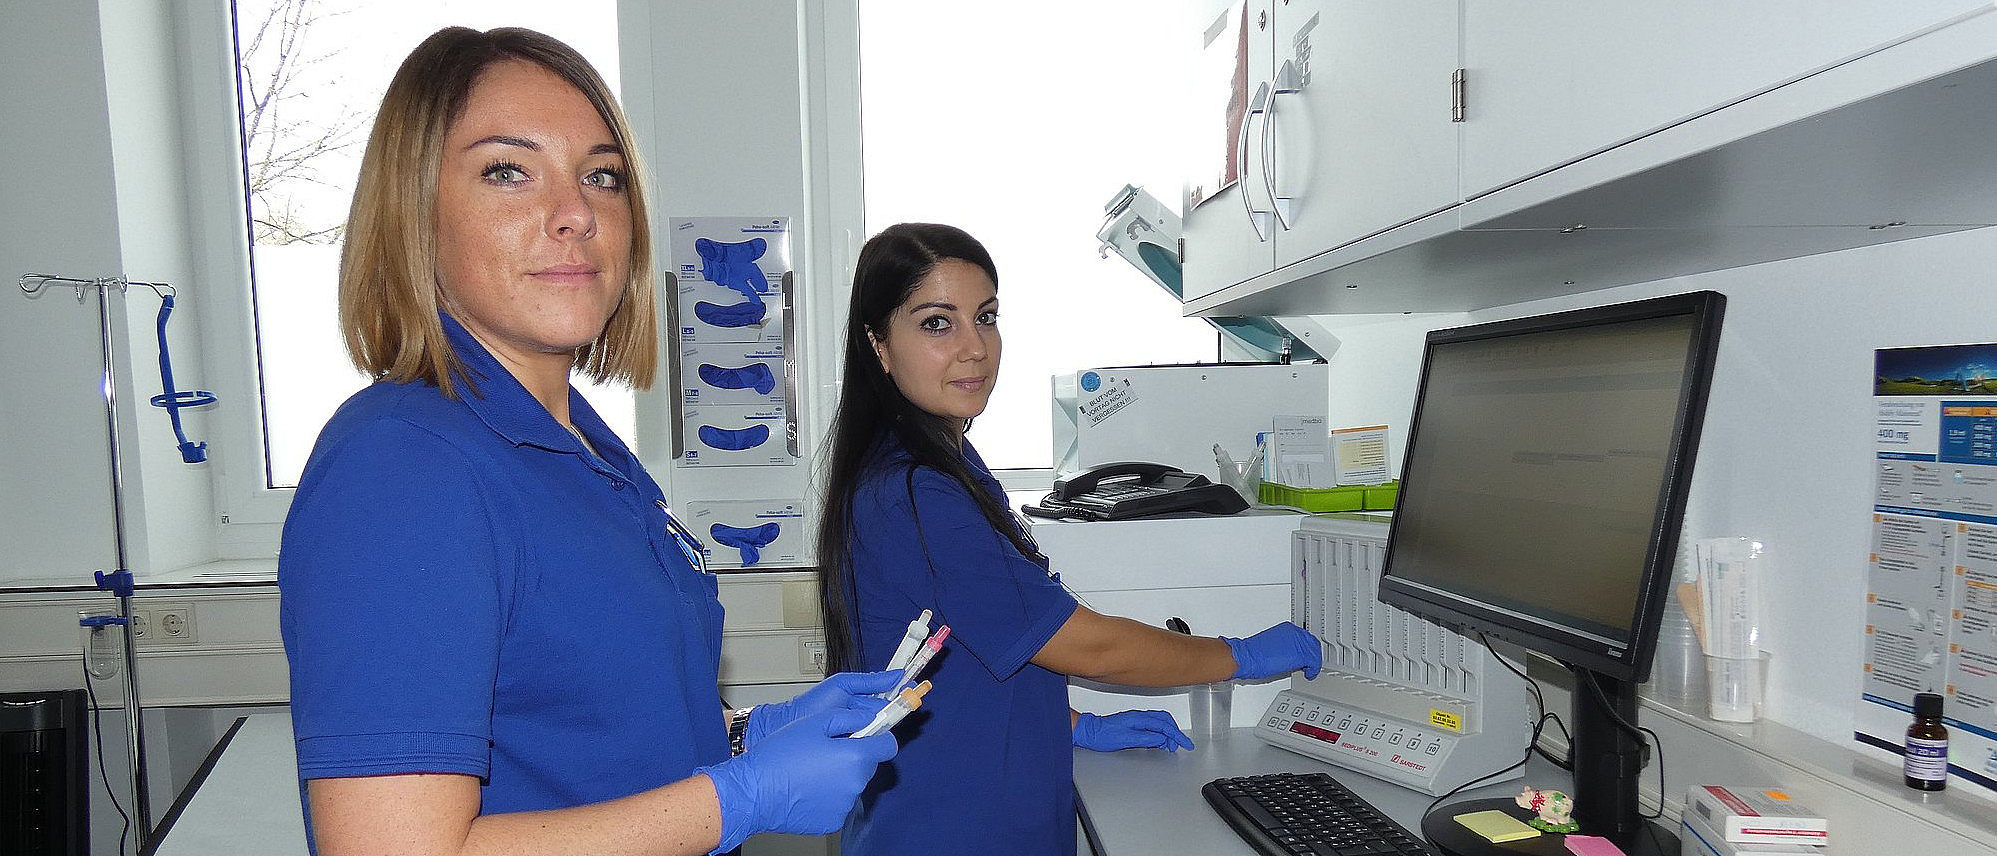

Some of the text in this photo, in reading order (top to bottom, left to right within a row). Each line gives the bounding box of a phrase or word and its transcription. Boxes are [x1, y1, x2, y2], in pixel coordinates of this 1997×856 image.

[782, 292, 791, 310] L
[784, 359, 795, 378] M
[1086, 390, 1127, 417] VORTAG NICHT
[1089, 387, 1118, 407] BLUT VOM
[1092, 400, 1125, 423] VERGESSEN
[786, 421, 797, 441] S
[1877, 429, 1909, 440] 400 mg
[1400, 759, 1426, 771] SARSTEDT
